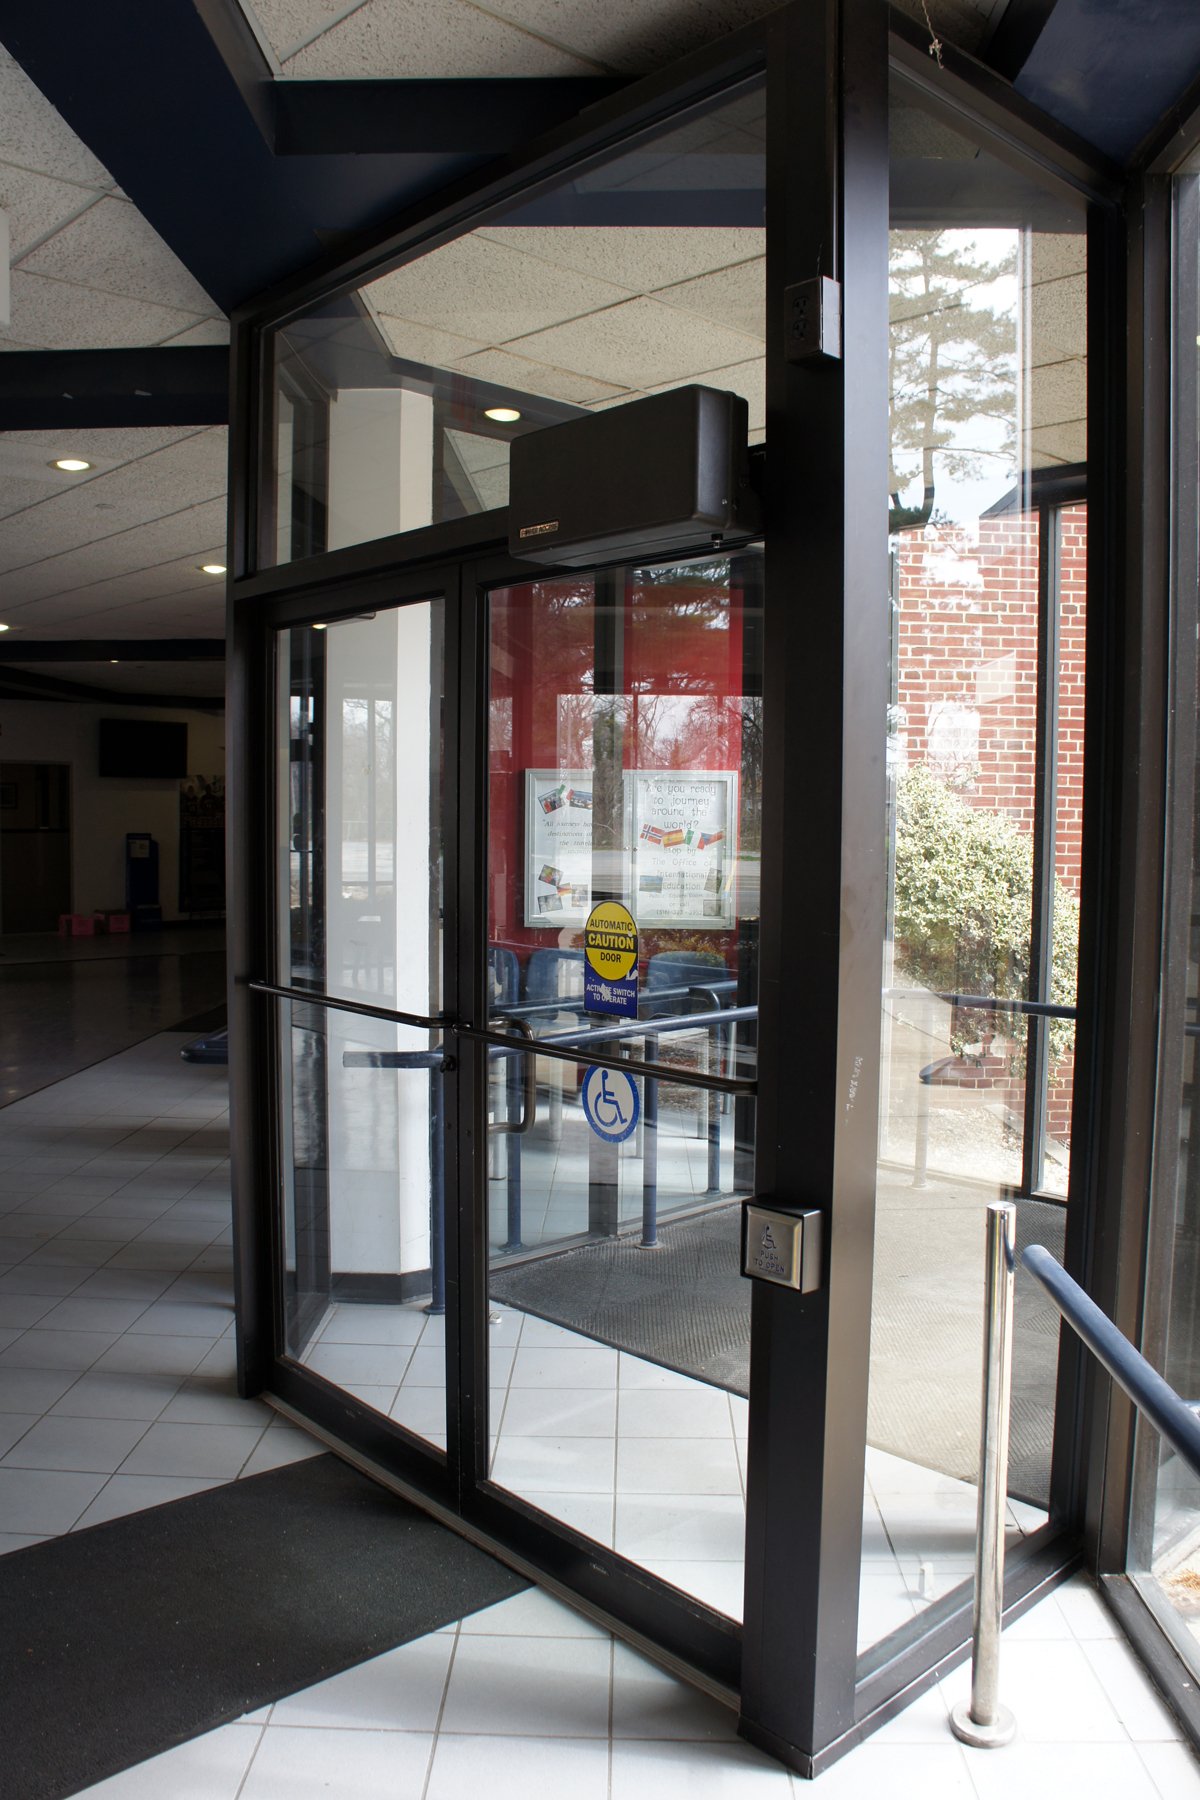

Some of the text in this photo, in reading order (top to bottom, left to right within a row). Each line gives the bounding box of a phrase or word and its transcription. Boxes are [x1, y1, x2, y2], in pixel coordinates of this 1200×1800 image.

[668, 785, 685, 795] you
[690, 783, 716, 796] ready
[670, 794, 709, 808] journey
[651, 807, 684, 816] around
[663, 819, 699, 829] world?
[590, 919, 633, 932] AUTOMATIC
[588, 933, 634, 950] CAUTION
[600, 952, 621, 963] DOOR
[586, 984, 635, 998] ACTITE SWITCH
[593, 993, 600, 1001] TO
[760, 1250, 779, 1261] PUSH
[753, 1258, 763, 1267] TO
[765, 1262, 785, 1273] OPEN
